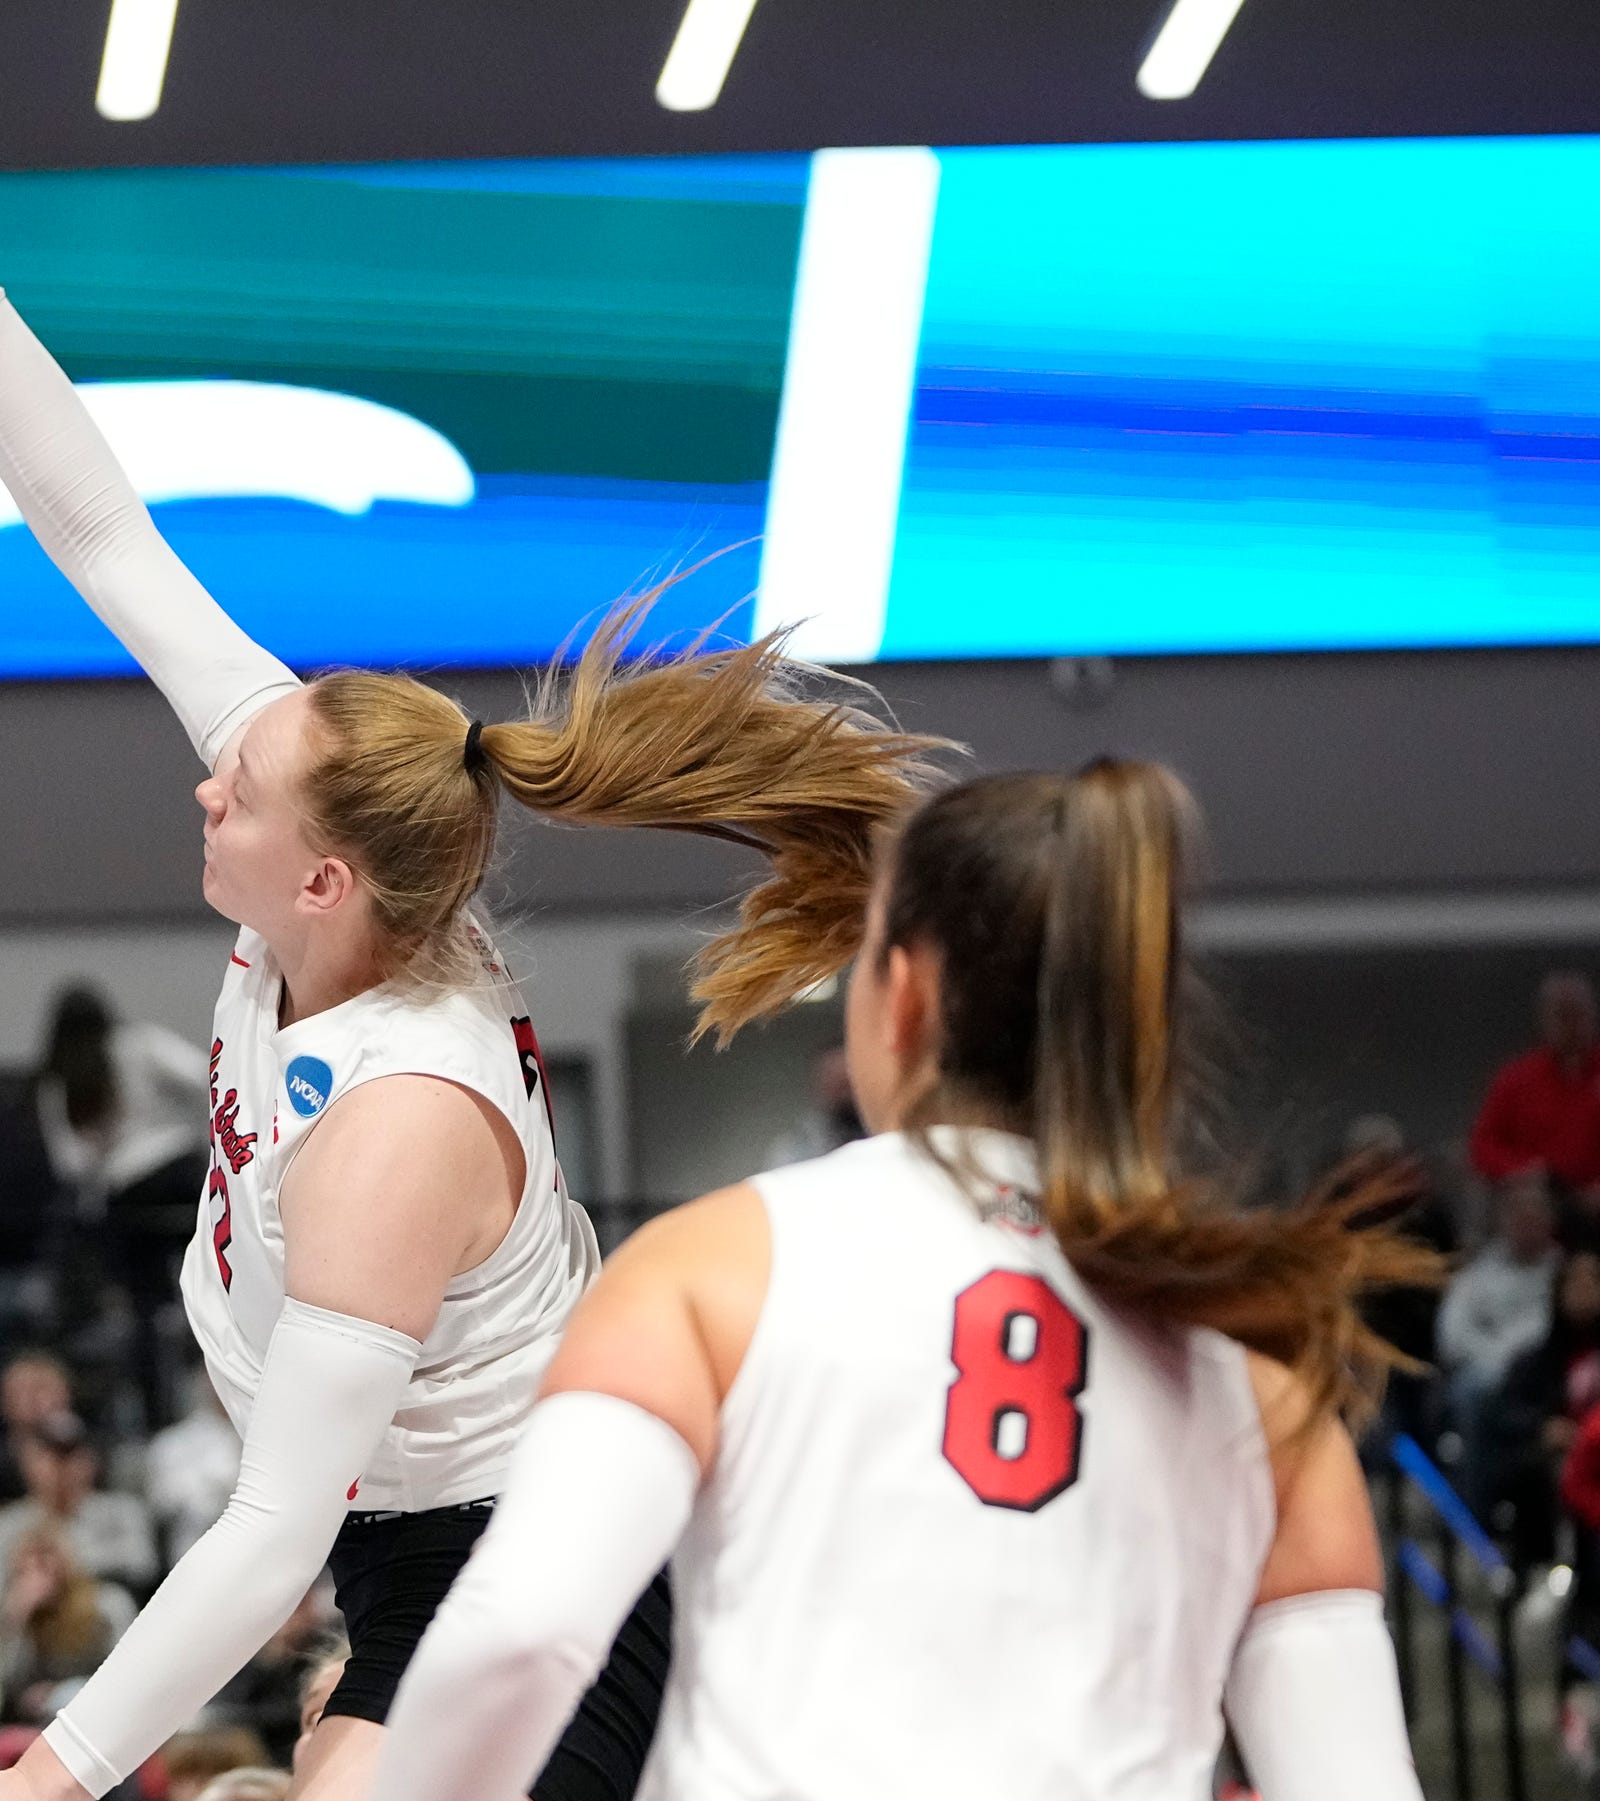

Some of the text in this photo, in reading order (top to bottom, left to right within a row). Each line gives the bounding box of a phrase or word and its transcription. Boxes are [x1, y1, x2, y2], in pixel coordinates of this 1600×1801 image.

[215, 1087, 258, 1175] State
[289, 1075, 325, 1111] NCAA
[941, 1268, 1089, 1514] 8
